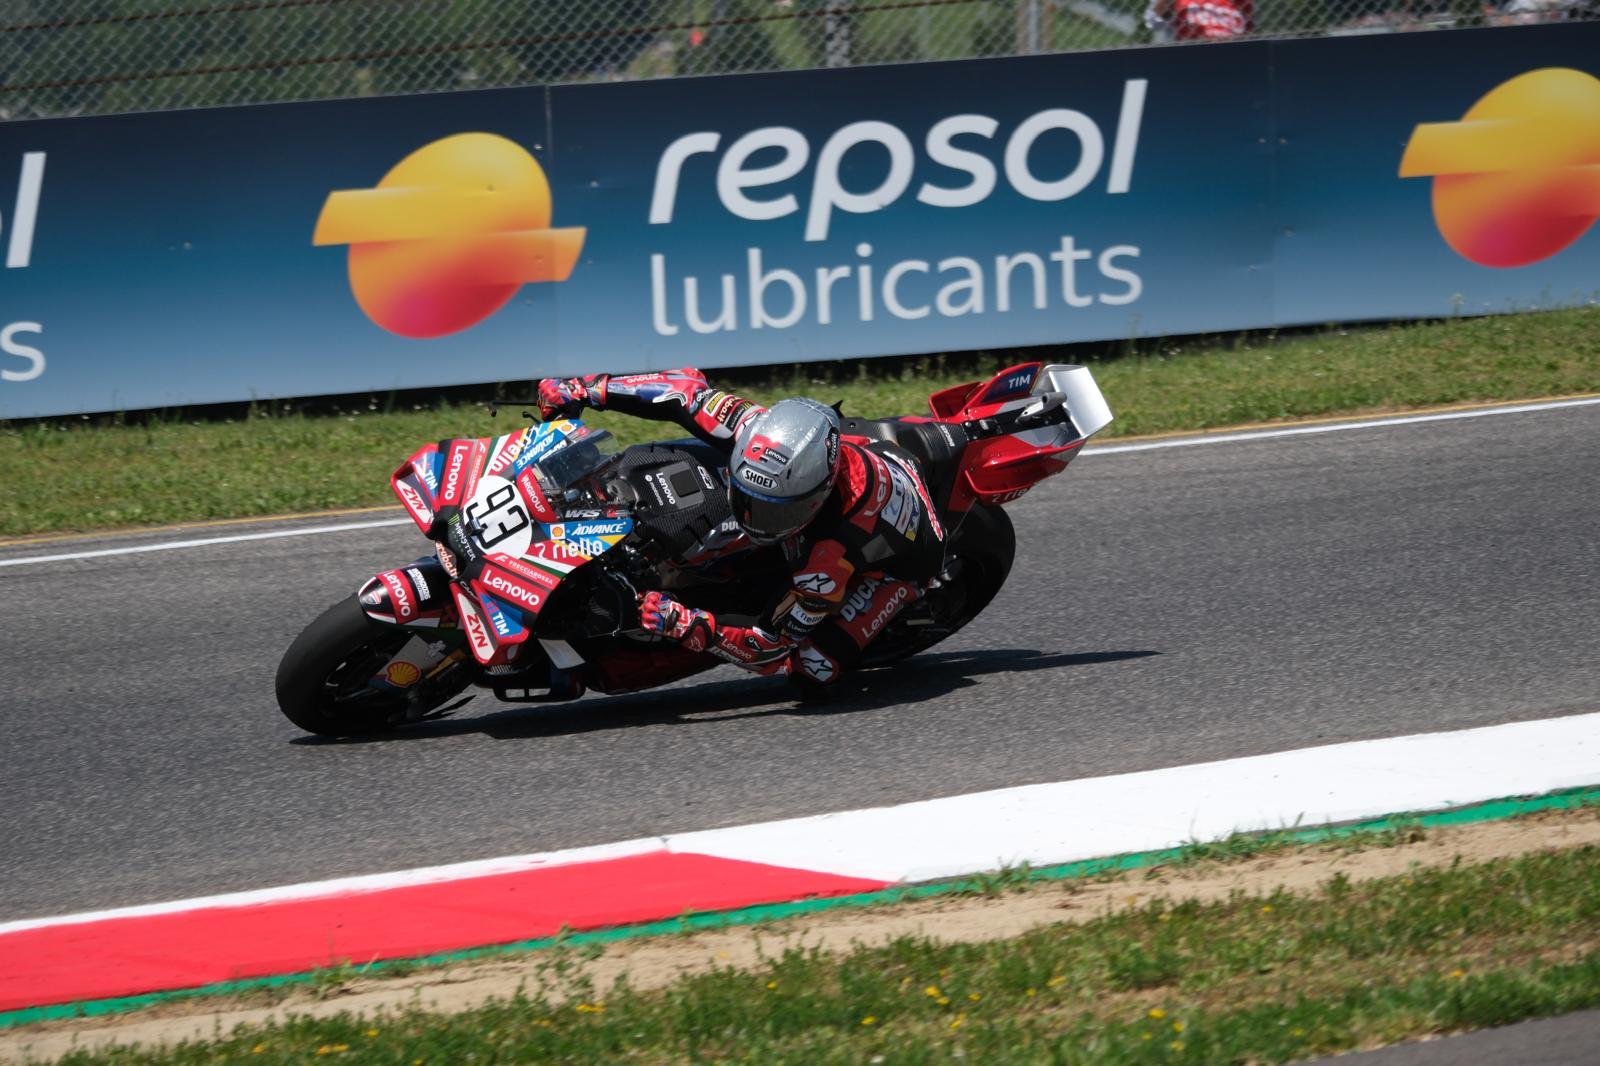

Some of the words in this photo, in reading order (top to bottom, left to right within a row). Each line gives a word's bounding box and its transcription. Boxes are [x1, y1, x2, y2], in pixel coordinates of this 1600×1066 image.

[649, 79, 1148, 242] repsol
[651, 236, 1143, 336] lubricants
[1008, 374, 1031, 390] TIM
[516, 432, 555, 470] ADVANCE
[765, 449, 787, 464] Lenovo
[424, 469, 438, 490] TIM
[445, 445, 469, 500] Lenovo
[656, 472, 676, 505] Lenovo
[744, 469, 773, 489] SHOEI
[403, 487, 427, 511] ZYN
[465, 484, 530, 548] 93
[454, 521, 477, 561] MONSTER
[571, 523, 625, 536] ADVANCE
[552, 538, 603, 559] riello
[384, 570, 411, 617] Lenovo
[482, 569, 540, 606] Lenovo
[841, 576, 881, 622] DUCA
[492, 612, 509, 635] TIM
[862, 586, 908, 639] Lenovo
[466, 613, 488, 648] ZYN
[721, 637, 752, 660] Lenovo
